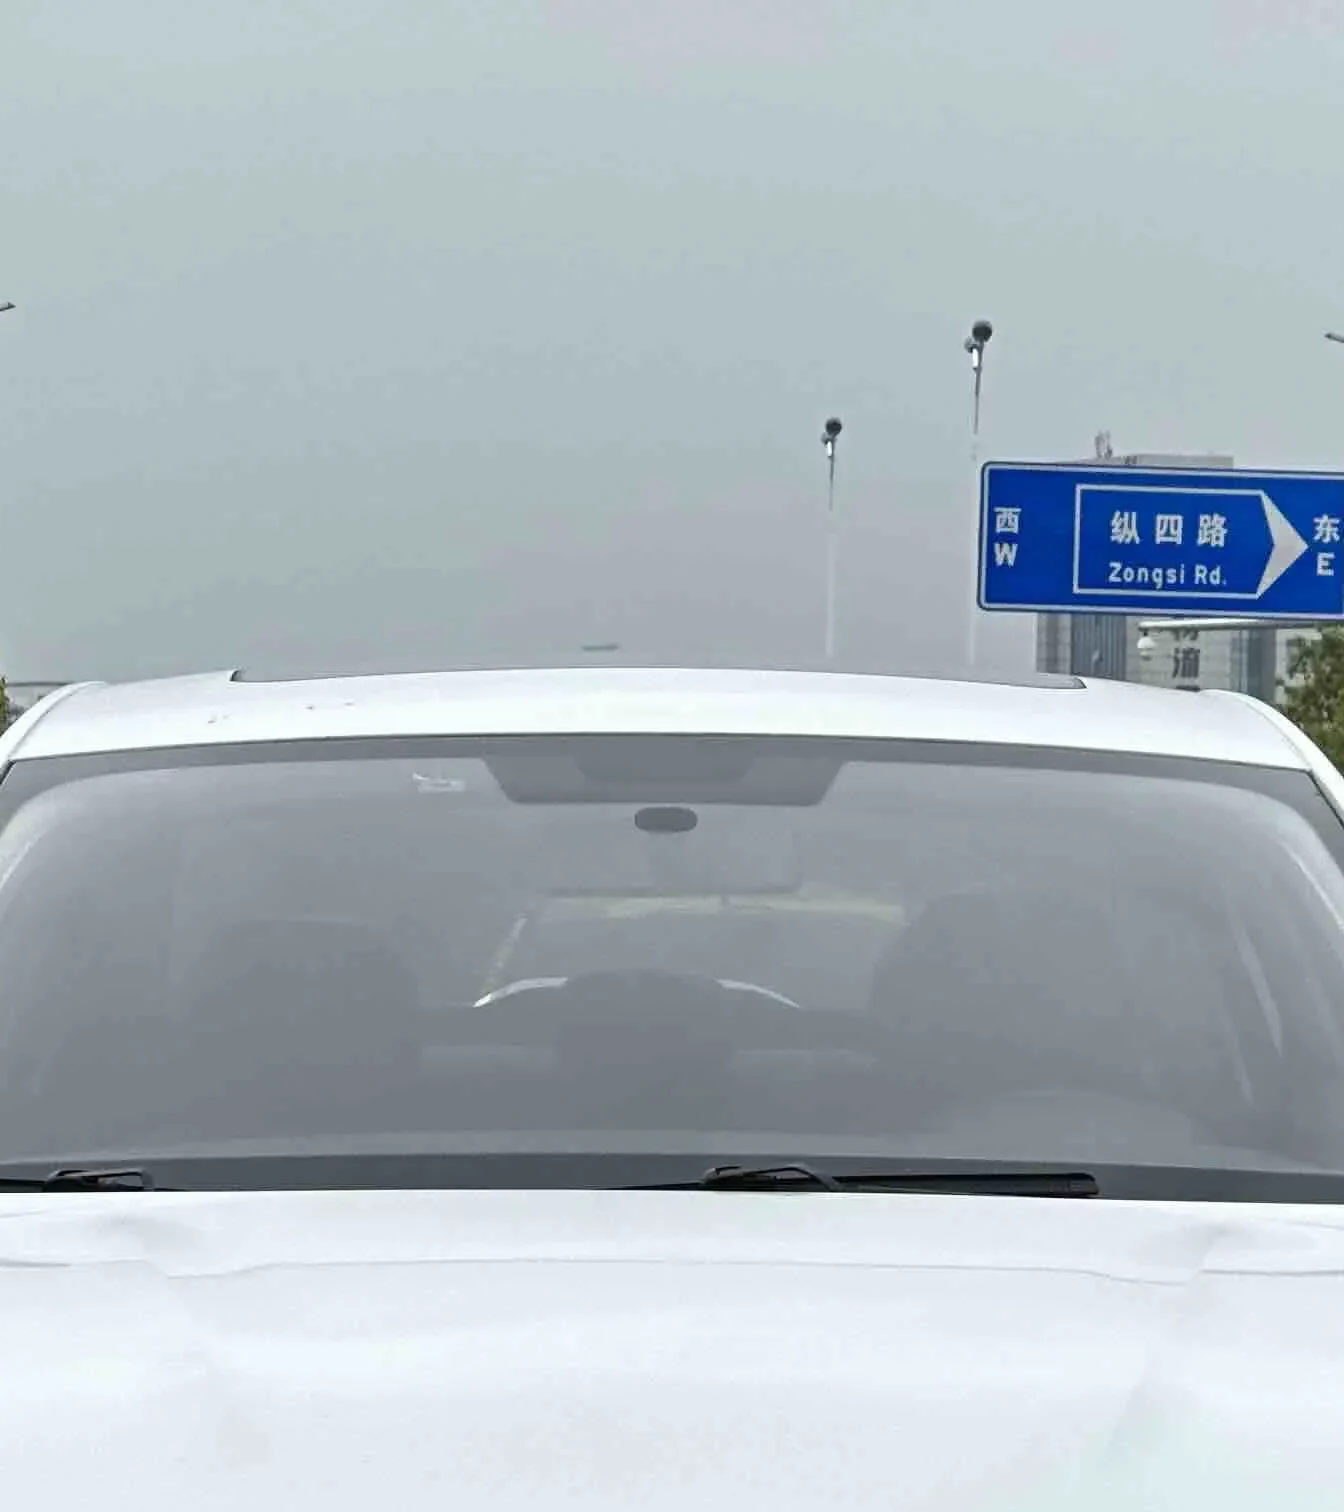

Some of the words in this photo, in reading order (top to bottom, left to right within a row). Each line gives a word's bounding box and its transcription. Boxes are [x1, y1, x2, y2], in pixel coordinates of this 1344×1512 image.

[993, 506, 1022, 535] 西
[1109, 510, 1229, 548] 纵四路
[1313, 514, 1341, 545] 东
[993, 543, 1019, 568] W
[1316, 552, 1336, 577] E
[1108, 562, 1185, 589] Zongsi
[1194, 564, 1228, 586] Rd.
